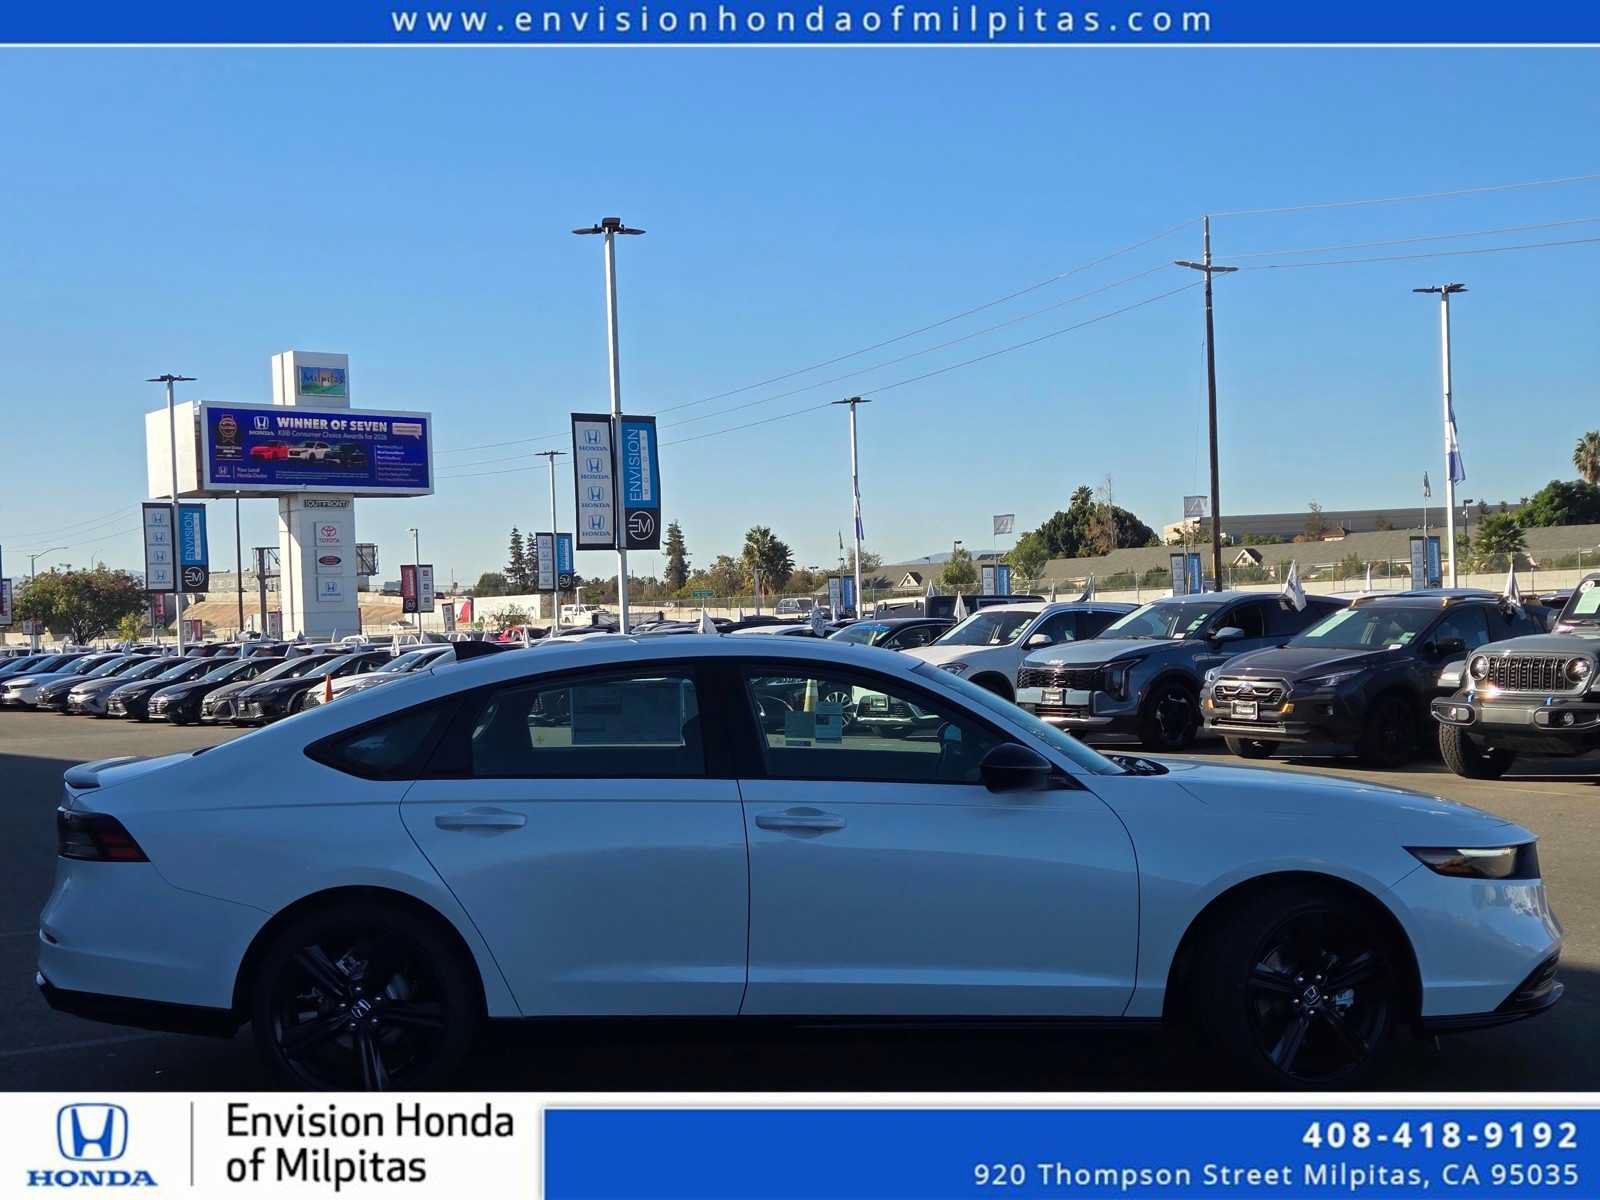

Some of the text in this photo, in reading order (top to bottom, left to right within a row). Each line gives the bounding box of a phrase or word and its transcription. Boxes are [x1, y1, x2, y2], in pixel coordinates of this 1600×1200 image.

[276, 416, 328, 430] WINNER
[330, 419, 348, 431] OF
[350, 421, 388, 433] SEVEN
[342, 432, 364, 440] Awards
[627, 429, 642, 501] ENVISION
[184, 512, 195, 561] ENVISION
